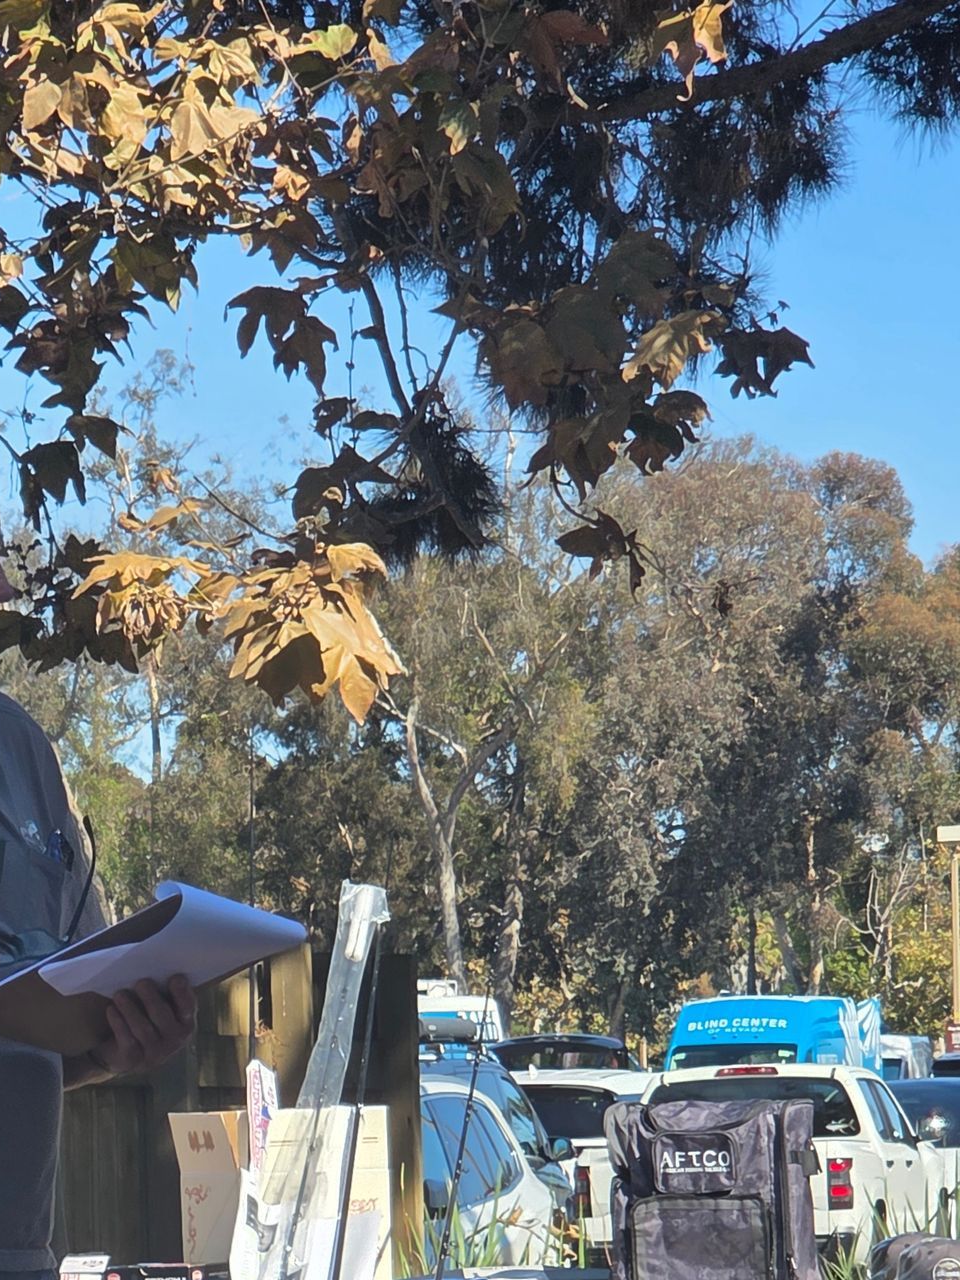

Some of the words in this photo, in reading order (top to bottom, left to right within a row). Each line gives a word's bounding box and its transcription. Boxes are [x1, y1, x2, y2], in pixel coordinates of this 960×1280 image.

[687, 1019, 728, 1031] BLIND
[732, 1017, 787, 1029] CENTER
[660, 1149, 730, 1168] AFTCO
